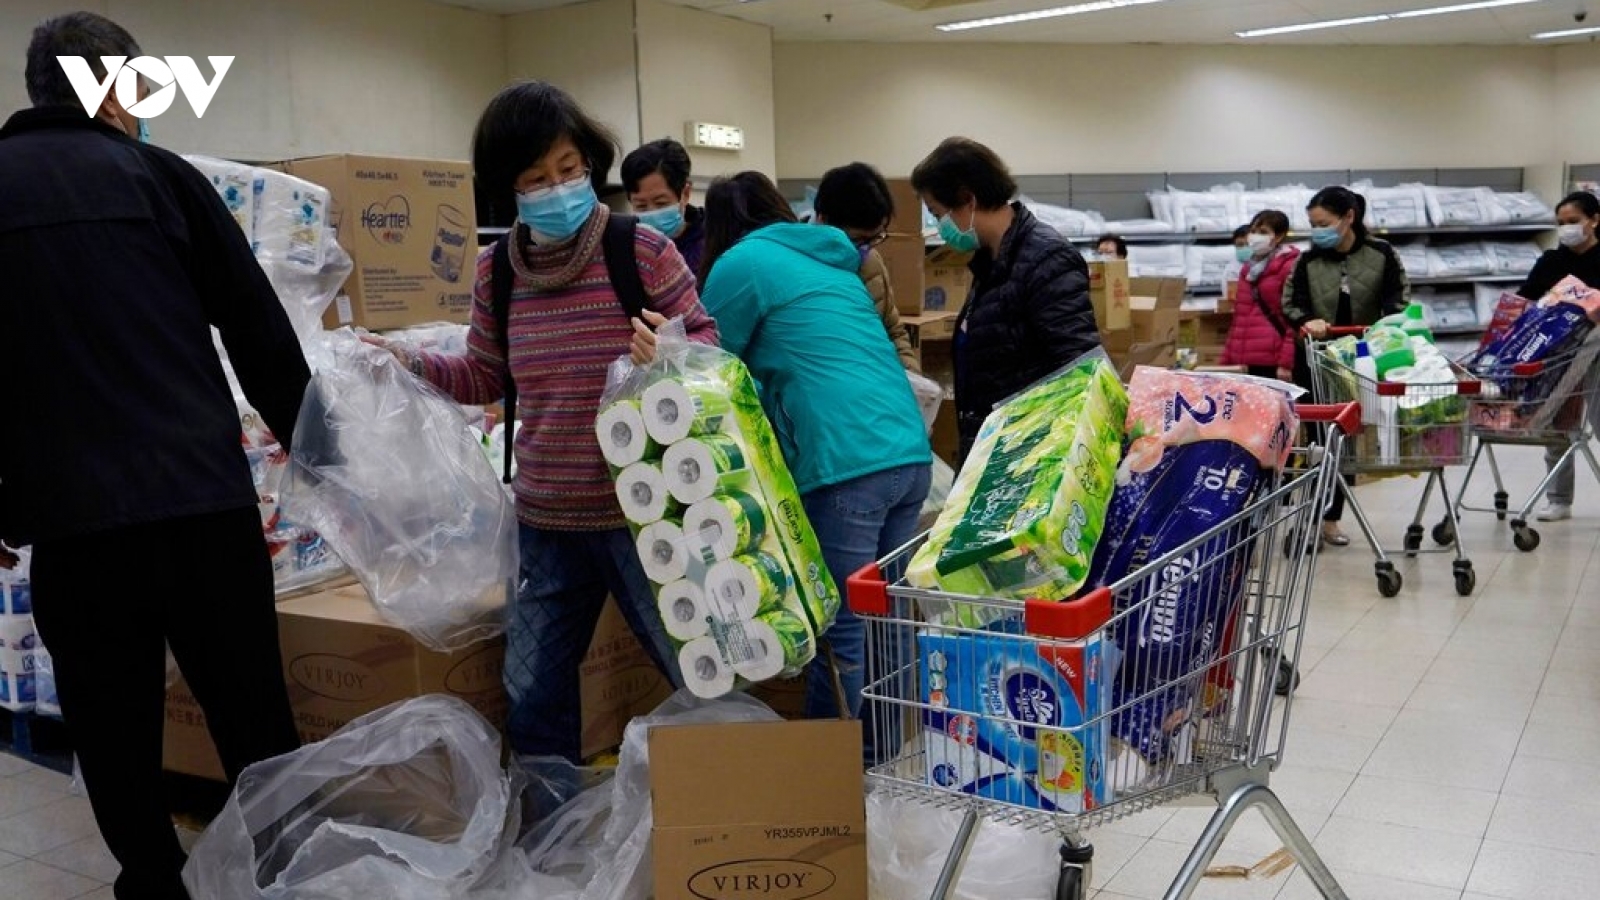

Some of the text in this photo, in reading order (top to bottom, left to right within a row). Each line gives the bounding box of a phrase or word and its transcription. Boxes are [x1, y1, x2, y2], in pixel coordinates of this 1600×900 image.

[1174, 391, 1217, 425] 2
[1222, 391, 1237, 421] Free
[1204, 467, 1227, 490] 10
[1143, 548, 1200, 646] Tempo
[303, 664, 367, 690] VIRJOY
[1055, 656, 1078, 679] NEW
[764, 825, 851, 840] YR355VPJML2
[713, 872, 809, 893] VIRJOY
